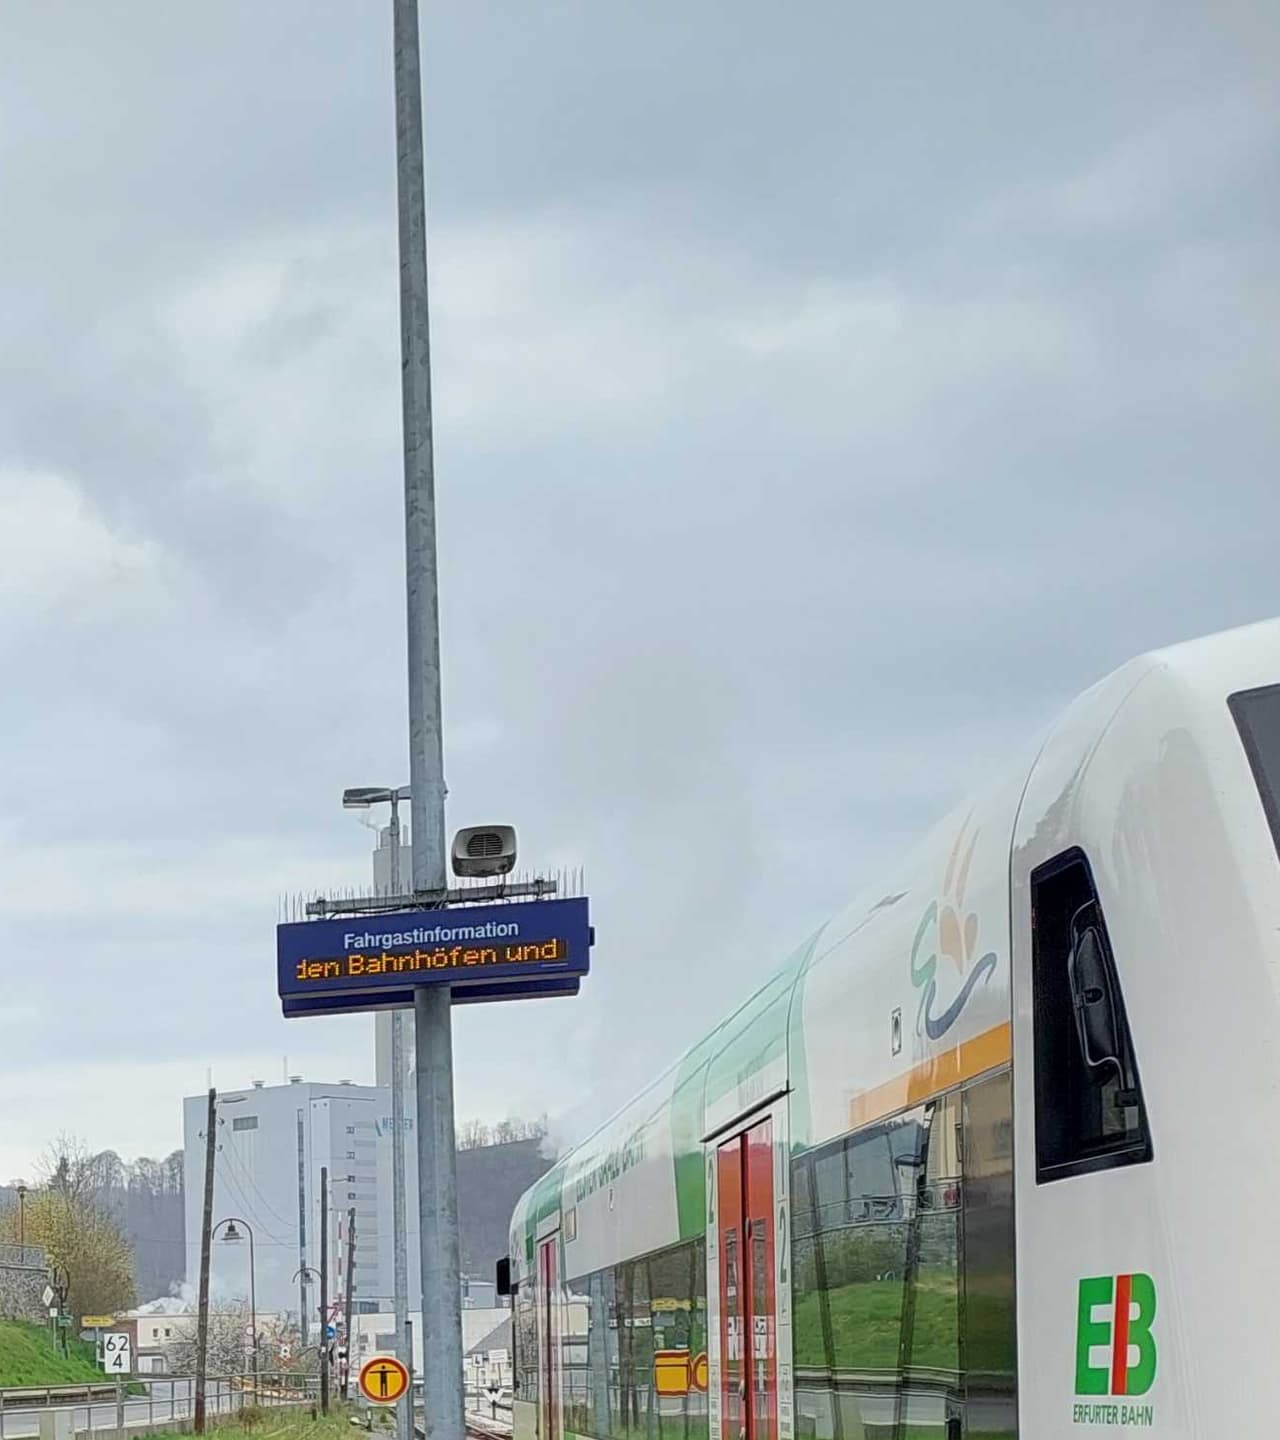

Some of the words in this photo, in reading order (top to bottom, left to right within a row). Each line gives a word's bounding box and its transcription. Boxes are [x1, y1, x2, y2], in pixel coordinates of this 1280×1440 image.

[344, 921, 519, 950] Fahrgastinformation
[348, 946, 497, 975] Bahnhöfen
[506, 938, 558, 962] und
[106, 1335, 129, 1352] 62
[112, 1353, 123, 1369] 4
[1073, 1404, 1119, 1425] ERFURTER
[1121, 1405, 1153, 1426] BAHN
